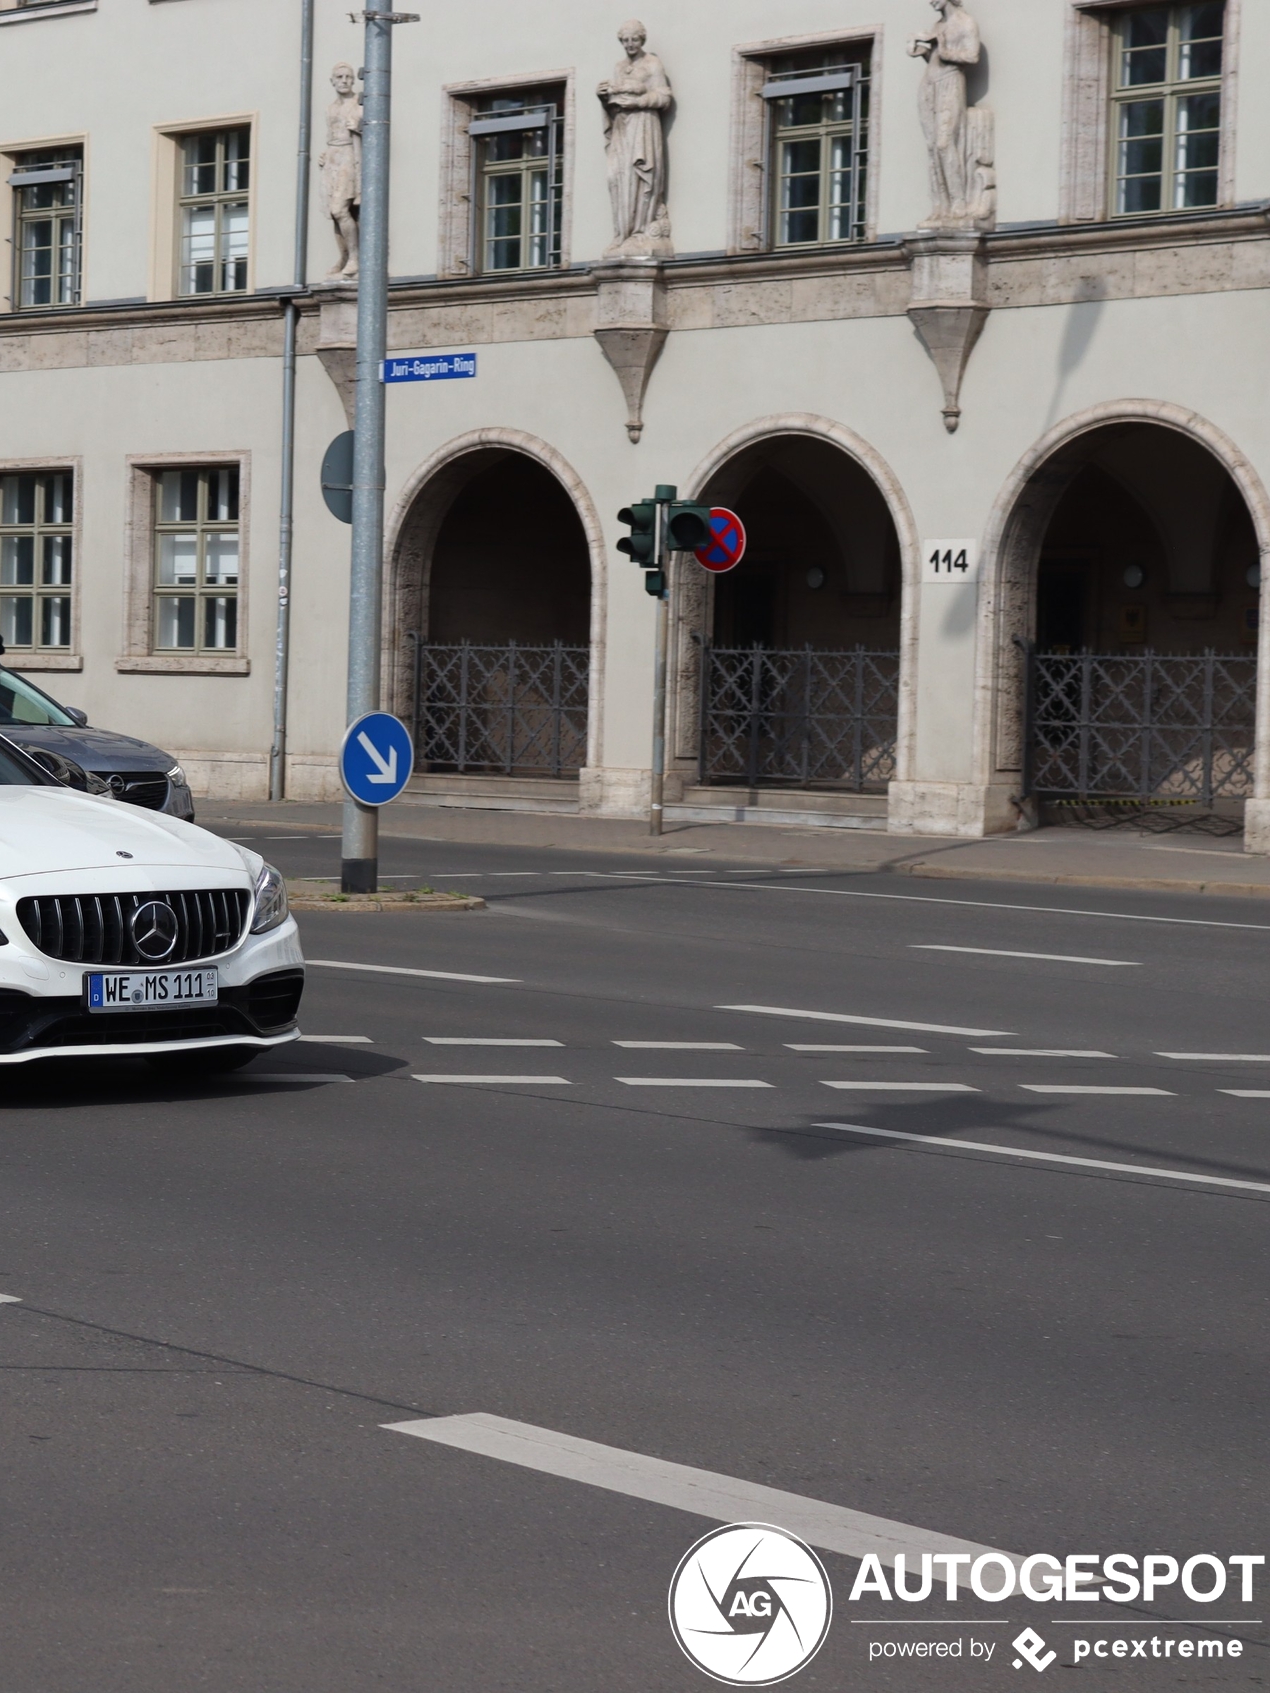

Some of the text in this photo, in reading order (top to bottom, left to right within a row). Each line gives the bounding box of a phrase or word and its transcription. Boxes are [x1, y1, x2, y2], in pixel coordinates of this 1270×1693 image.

[390, 357, 474, 378] Juri-Gagarin-Ring
[929, 549, 968, 573] 114
[206, 972, 215, 980] 03
[93, 973, 204, 1002] D WE MS 111
[207, 989, 215, 997] 10
